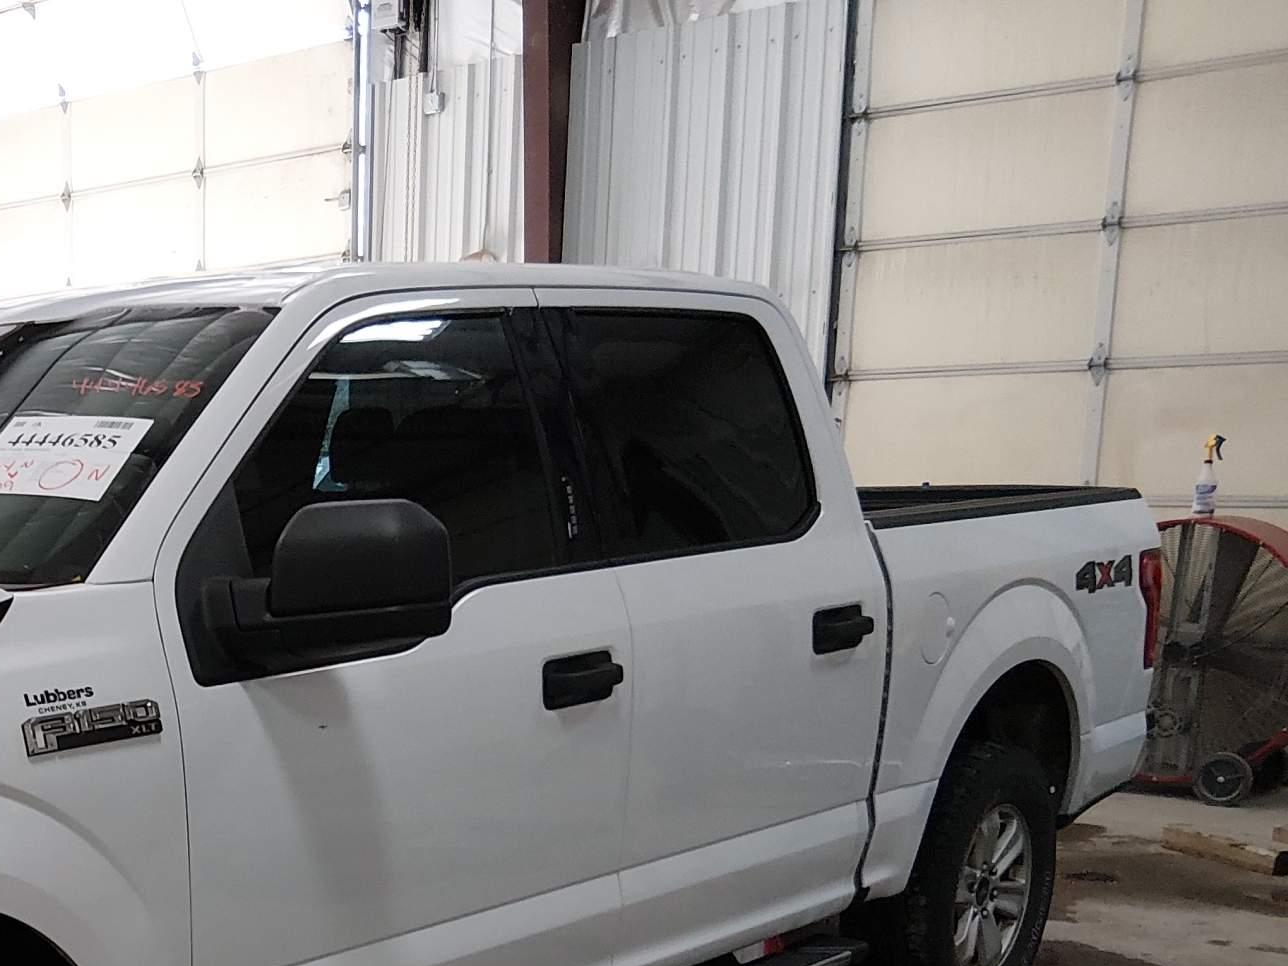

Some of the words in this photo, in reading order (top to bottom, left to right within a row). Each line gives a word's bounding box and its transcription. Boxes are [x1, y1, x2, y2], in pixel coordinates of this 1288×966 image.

[8, 433, 122, 449] 44446585
[23, 686, 94, 707] Lubbers
[131, 723, 159, 735] XLT
